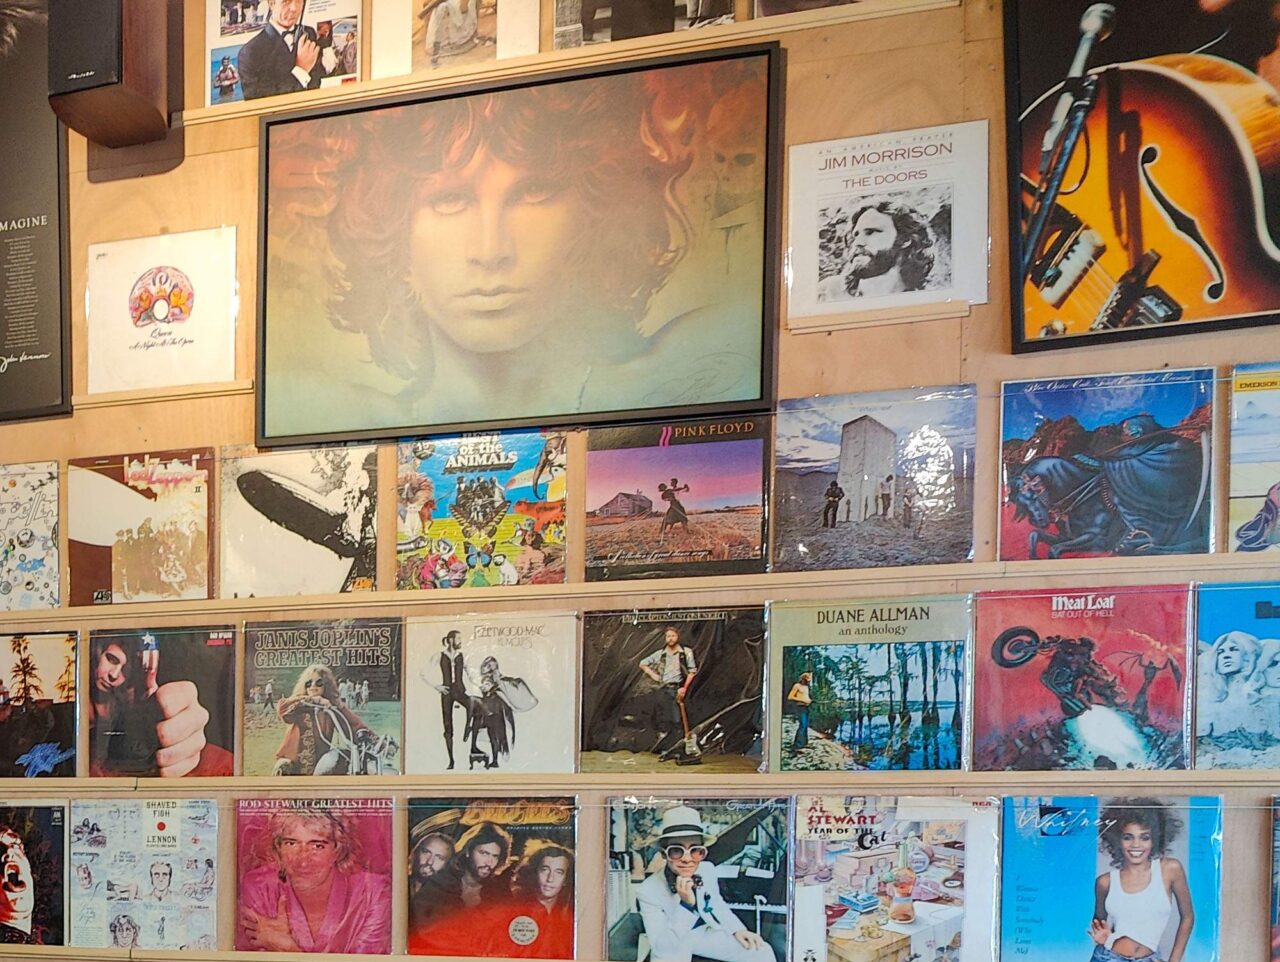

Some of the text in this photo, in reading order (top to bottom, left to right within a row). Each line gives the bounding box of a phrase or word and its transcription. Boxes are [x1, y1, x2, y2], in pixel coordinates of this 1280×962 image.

[819, 142, 953, 171] JIM MORRISON
[842, 169, 928, 189] THE DOORS
[675, 421, 754, 438] PINK FLOYD
[460, 442, 503, 454] of the
[446, 451, 518, 468] ANIMALS
[1051, 595, 1116, 611] Meat Loaf
[817, 606, 930, 625] DUANE ALLMAN
[1051, 611, 1066, 619] BAT
[1095, 610, 1115, 618] HELL
[839, 624, 909, 636] an anthology
[255, 630, 309, 650] JANIS
[309, 627, 391, 648] JOPLIN'S
[254, 646, 391, 668] GREATEST HITS
[146, 801, 177, 809] SHAVED
[239, 799, 393, 809] ROD STEWART GREATEST HITS
[808, 806, 828, 814] AL
[153, 809, 171, 817] FISH
[808, 815, 877, 825] STEWART
[853, 826, 874, 834] THE
[1019, 808, 1118, 839] Whitney
[146, 835, 177, 843] LENNON
[858, 831, 887, 850] Cat
